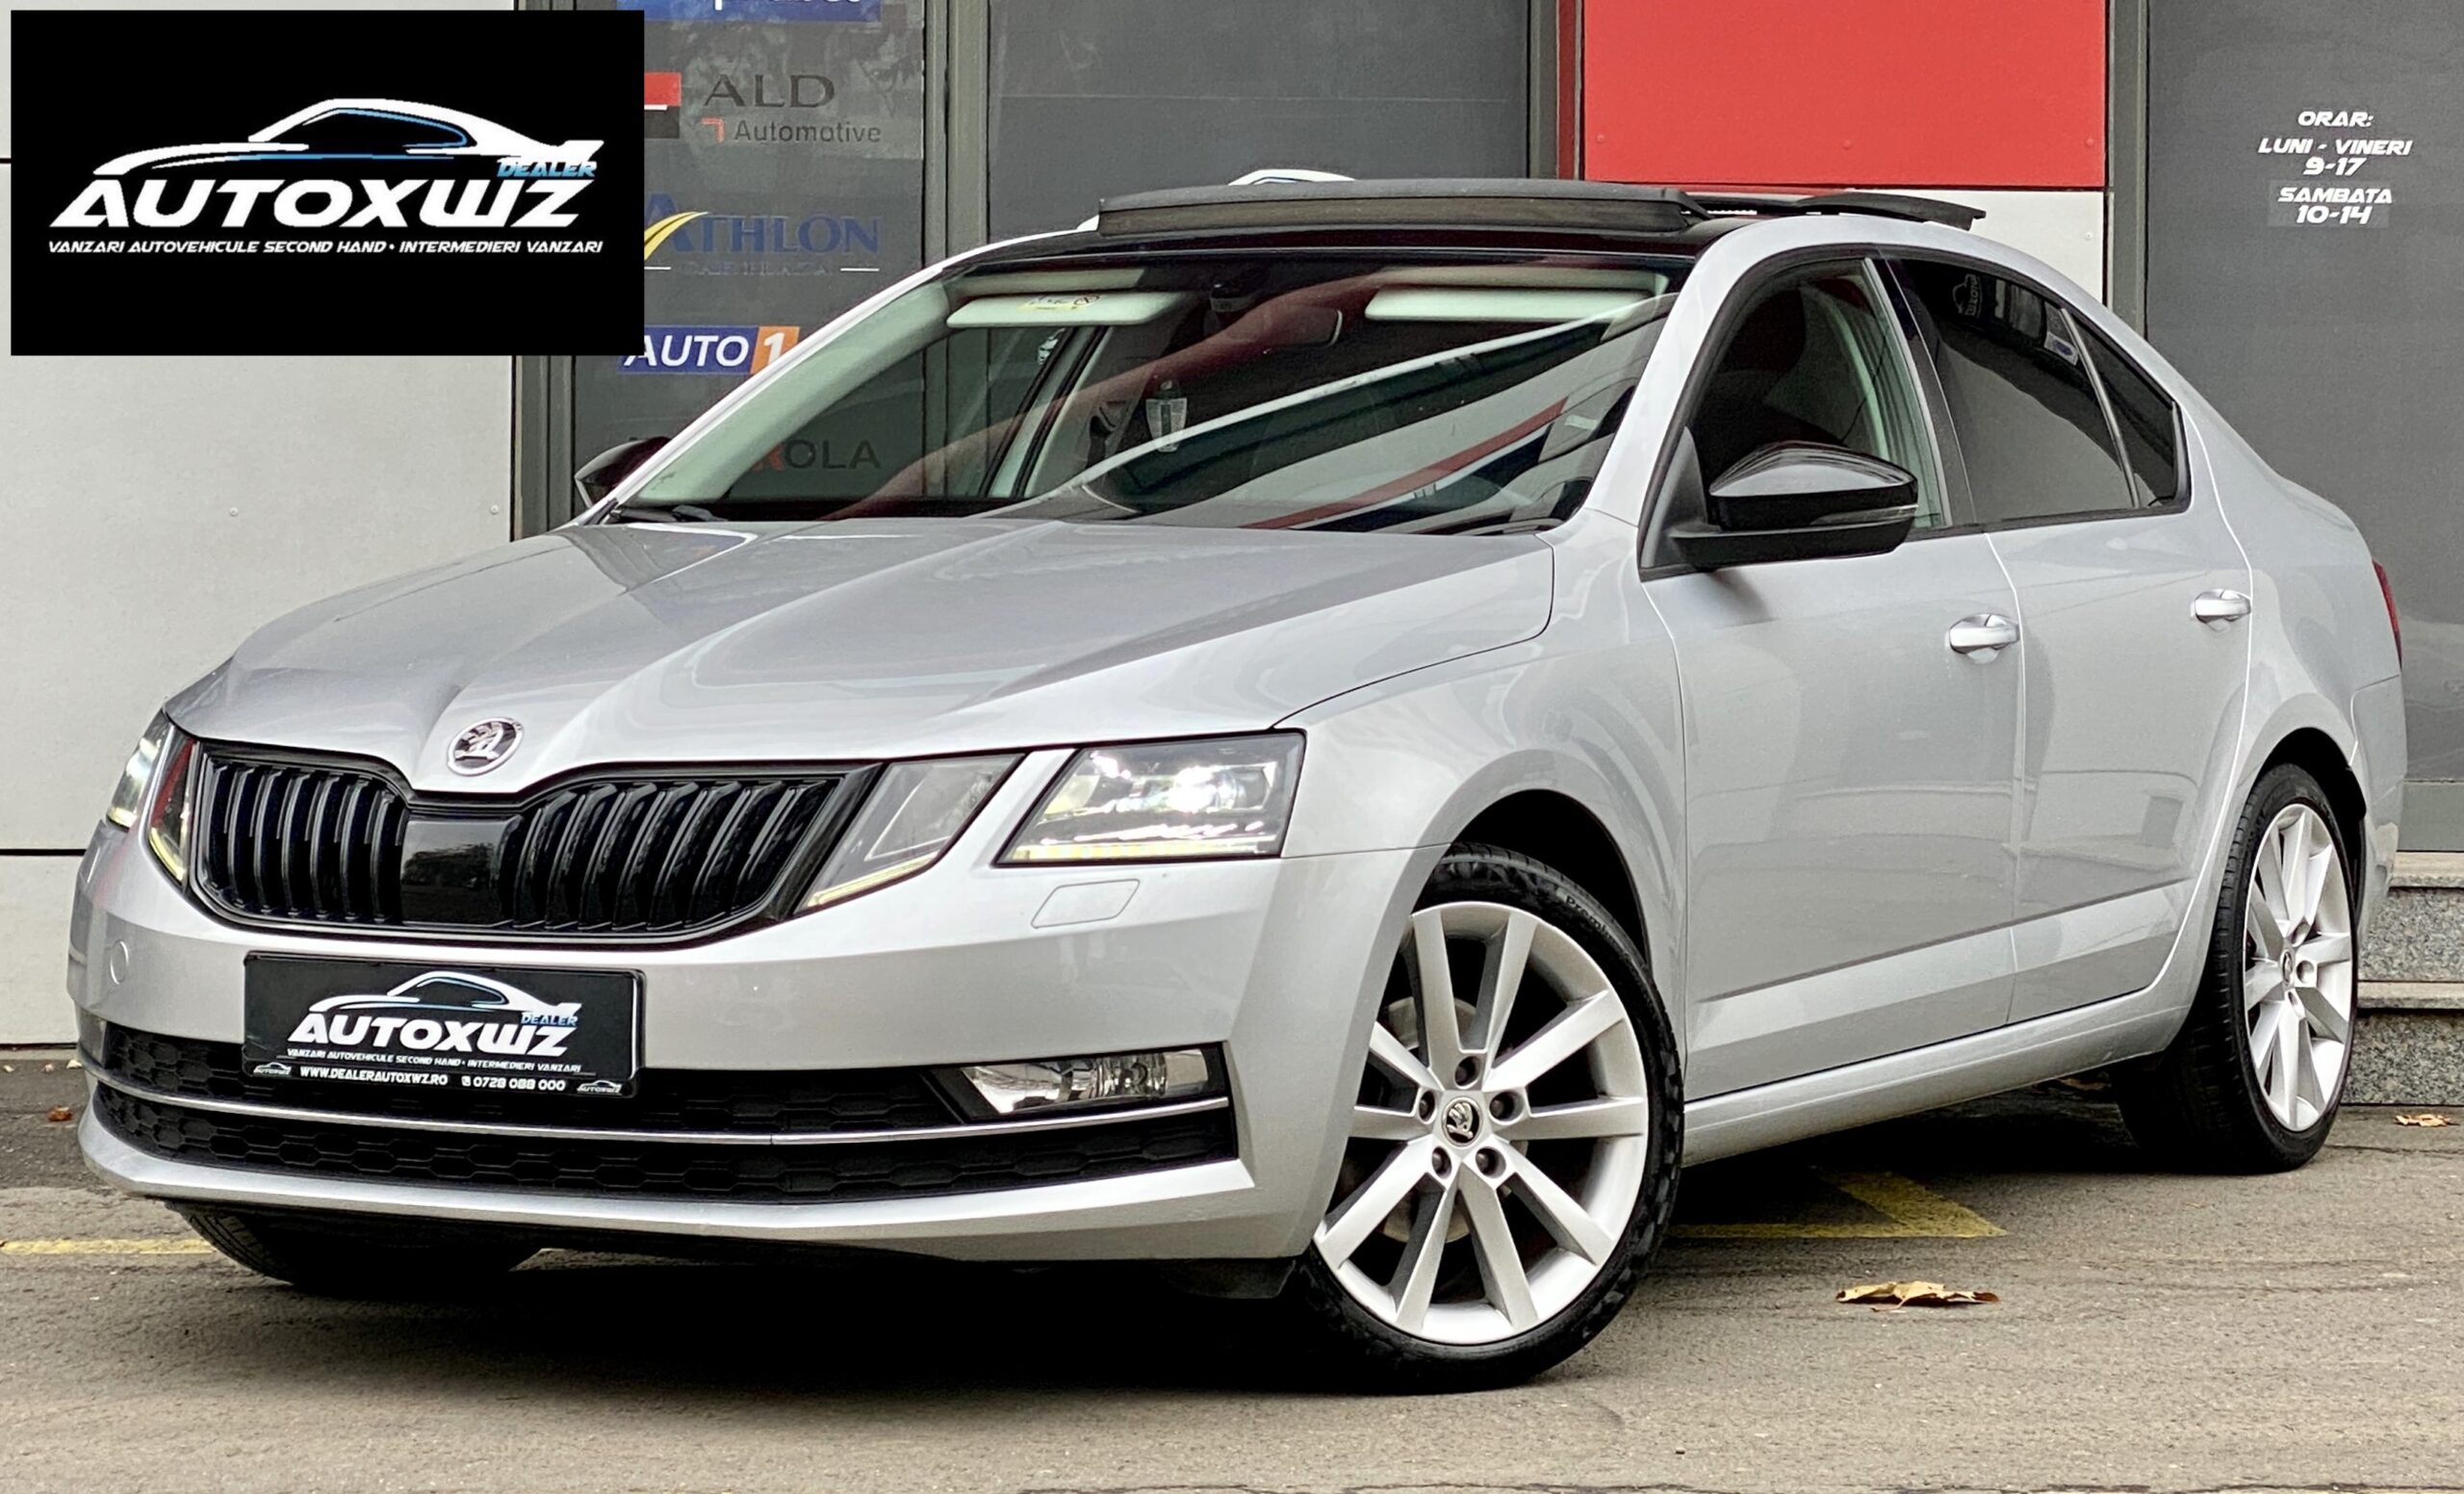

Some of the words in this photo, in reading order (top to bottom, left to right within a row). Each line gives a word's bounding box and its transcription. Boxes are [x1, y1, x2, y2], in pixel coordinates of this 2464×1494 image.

[704, 74, 835, 108] ALD
[2297, 111, 2374, 127] ORAR:
[733, 119, 881, 142] Automotive
[2257, 137, 2313, 154] LUNI
[2335, 139, 2413, 156] VINERI
[2302, 156, 2367, 176] 9-17
[2277, 187, 2393, 204] SAMBATA
[2297, 204, 2373, 224] 10-14
[521, 1013, 578, 1026] DEALER
[288, 1014, 577, 1057] AUTOXWZ
[287, 1048, 325, 1059] VANZARI
[327, 1051, 394, 1064] AUTOVEHICULE
[396, 1055, 433, 1066] SECOND
[434, 1058, 462, 1068] HAND
[467, 1060, 535, 1071] INTERMEDIERI
[537, 1064, 581, 1073] VANZARI
[538, 1081, 566, 1092] 000
